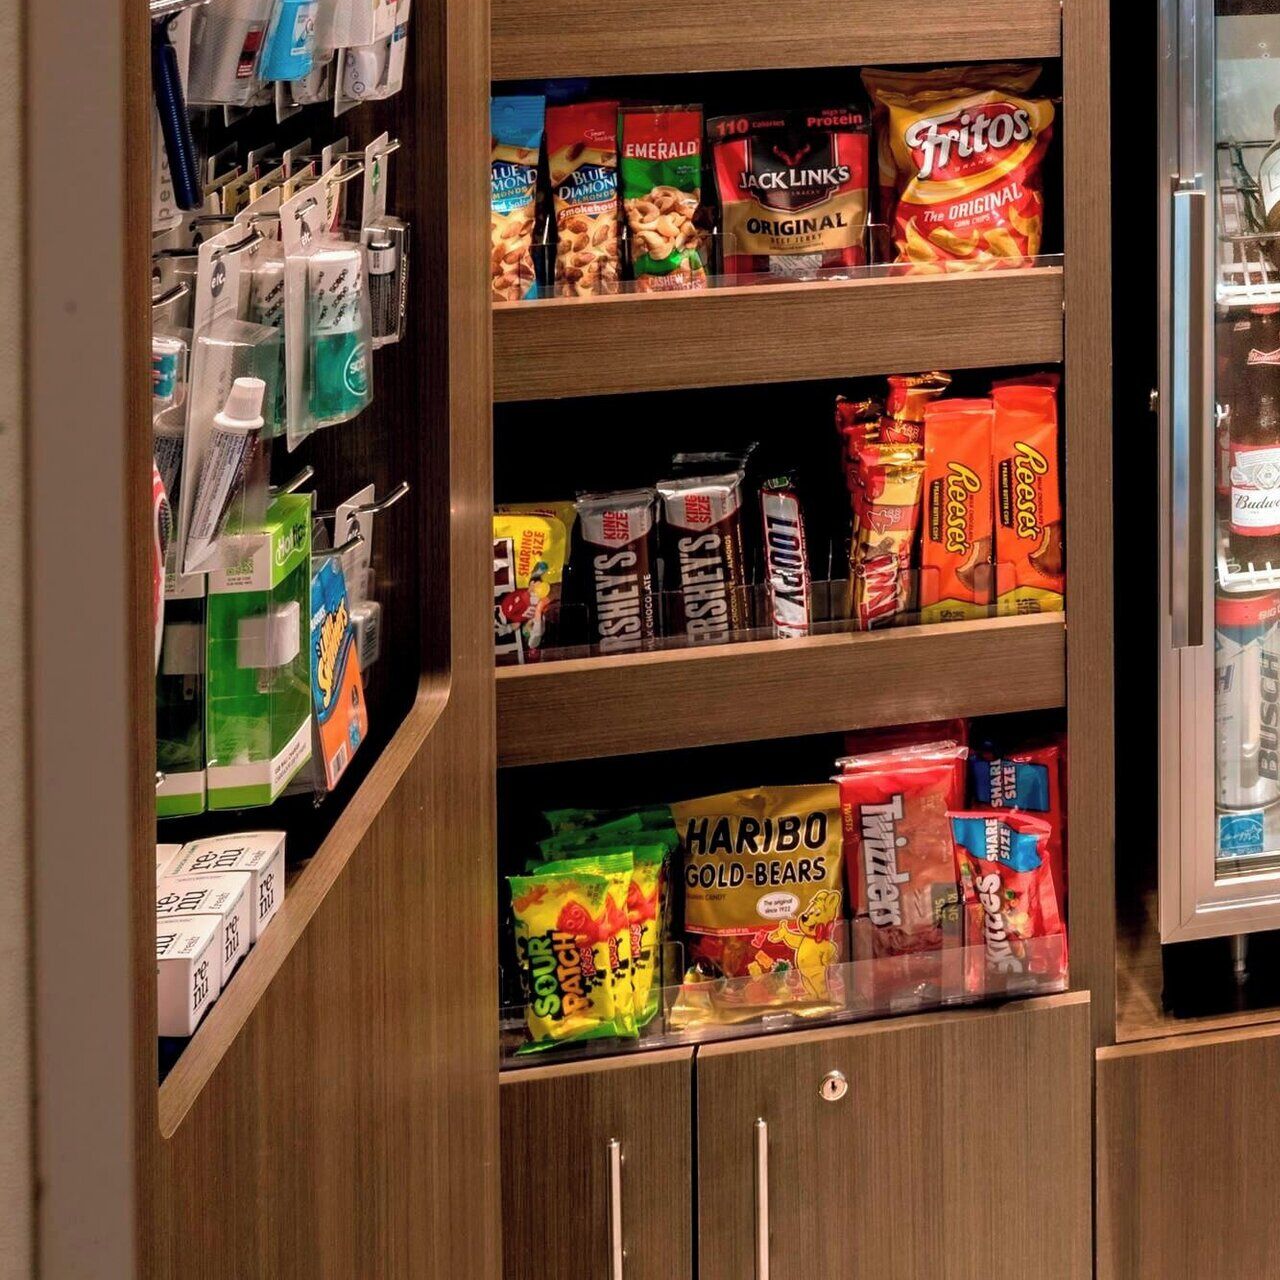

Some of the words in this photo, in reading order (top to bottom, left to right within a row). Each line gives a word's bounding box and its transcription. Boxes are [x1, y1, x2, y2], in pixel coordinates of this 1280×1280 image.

[717, 117, 749, 136] 110
[806, 113, 863, 128] Protein
[626, 138, 697, 160] EMERALD
[905, 108, 1030, 179] Fritos
[573, 168, 608, 185] BLUE
[739, 171, 789, 190] JACK
[789, 165, 850, 188] LINK'S
[924, 210, 945, 222] The
[949, 182, 1023, 220] ORIGINAL
[746, 212, 848, 236] ORIGINAL
[954, 220, 970, 228] CORN
[971, 214, 990, 225] CHIPS
[1013, 441, 1048, 541] Reese's
[684, 494, 699, 524] KING
[699, 495, 712, 524] SIZE
[945, 461, 981, 555] Reese's
[603, 510, 616, 540] KING
[616, 512, 629, 541] SIZE
[518, 530, 533, 577] SHARING
[532, 531, 545, 557] SIZE
[724, 534, 734, 569] ALMONDS
[1258, 651, 1280, 781] BUSCH
[1004, 765, 1016, 800] SIZE
[843, 802, 853, 833] TWISTS
[686, 811, 827, 856] HARIBO
[986, 819, 999, 863] SHARE
[1000, 828, 1012, 860] SIZE
[246, 848, 264, 869] fresh
[685, 856, 827, 889] GOLD-BEARS
[859, 793, 910, 927] Twizzlers
[209, 890, 231, 912] fresh
[774, 898, 793, 908] original
[778, 905, 791, 913] 1922
[528, 937, 561, 1017] SOUR
[552, 932, 586, 1015] PATCH
